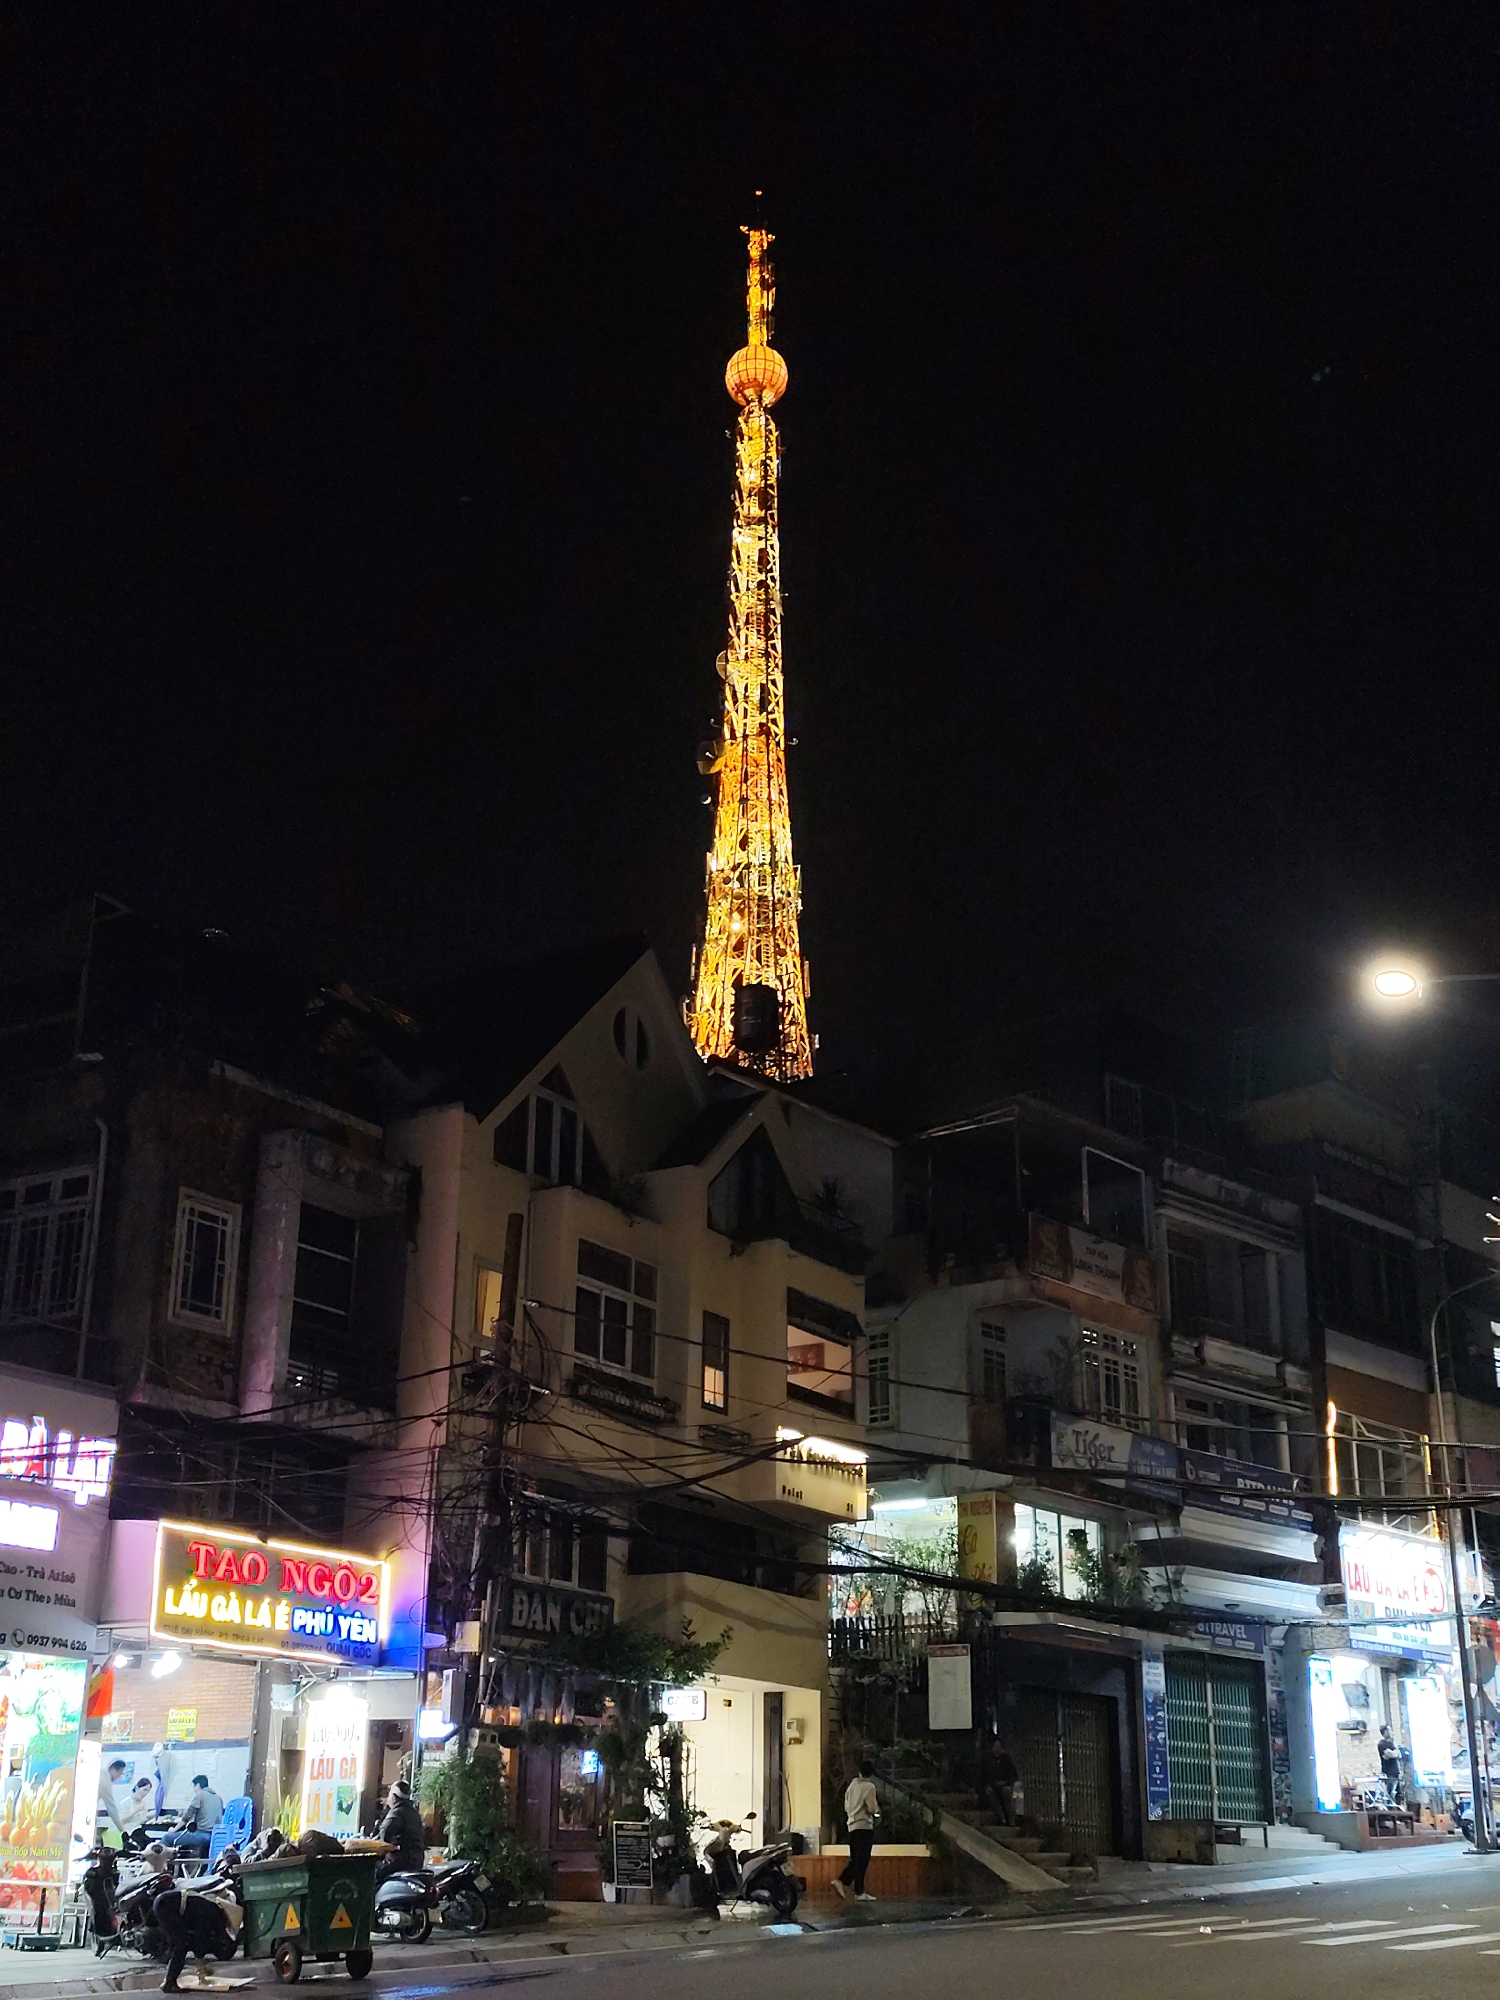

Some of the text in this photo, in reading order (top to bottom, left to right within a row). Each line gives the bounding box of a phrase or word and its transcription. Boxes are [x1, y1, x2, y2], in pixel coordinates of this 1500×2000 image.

[1072, 1427, 1115, 1469] Tiger
[26, 1565, 45, 1579] Trà
[188, 1541, 268, 1586] TAO
[211, 1592, 241, 1624] GÀ
[244, 1599, 271, 1629] LÁ
[274, 1600, 290, 1631] É
[292, 1605, 335, 1636] PHÚ
[337, 1611, 378, 1643] YÊN
[26, 1634, 50, 1648] 0937
[70, 1639, 88, 1652] 626
